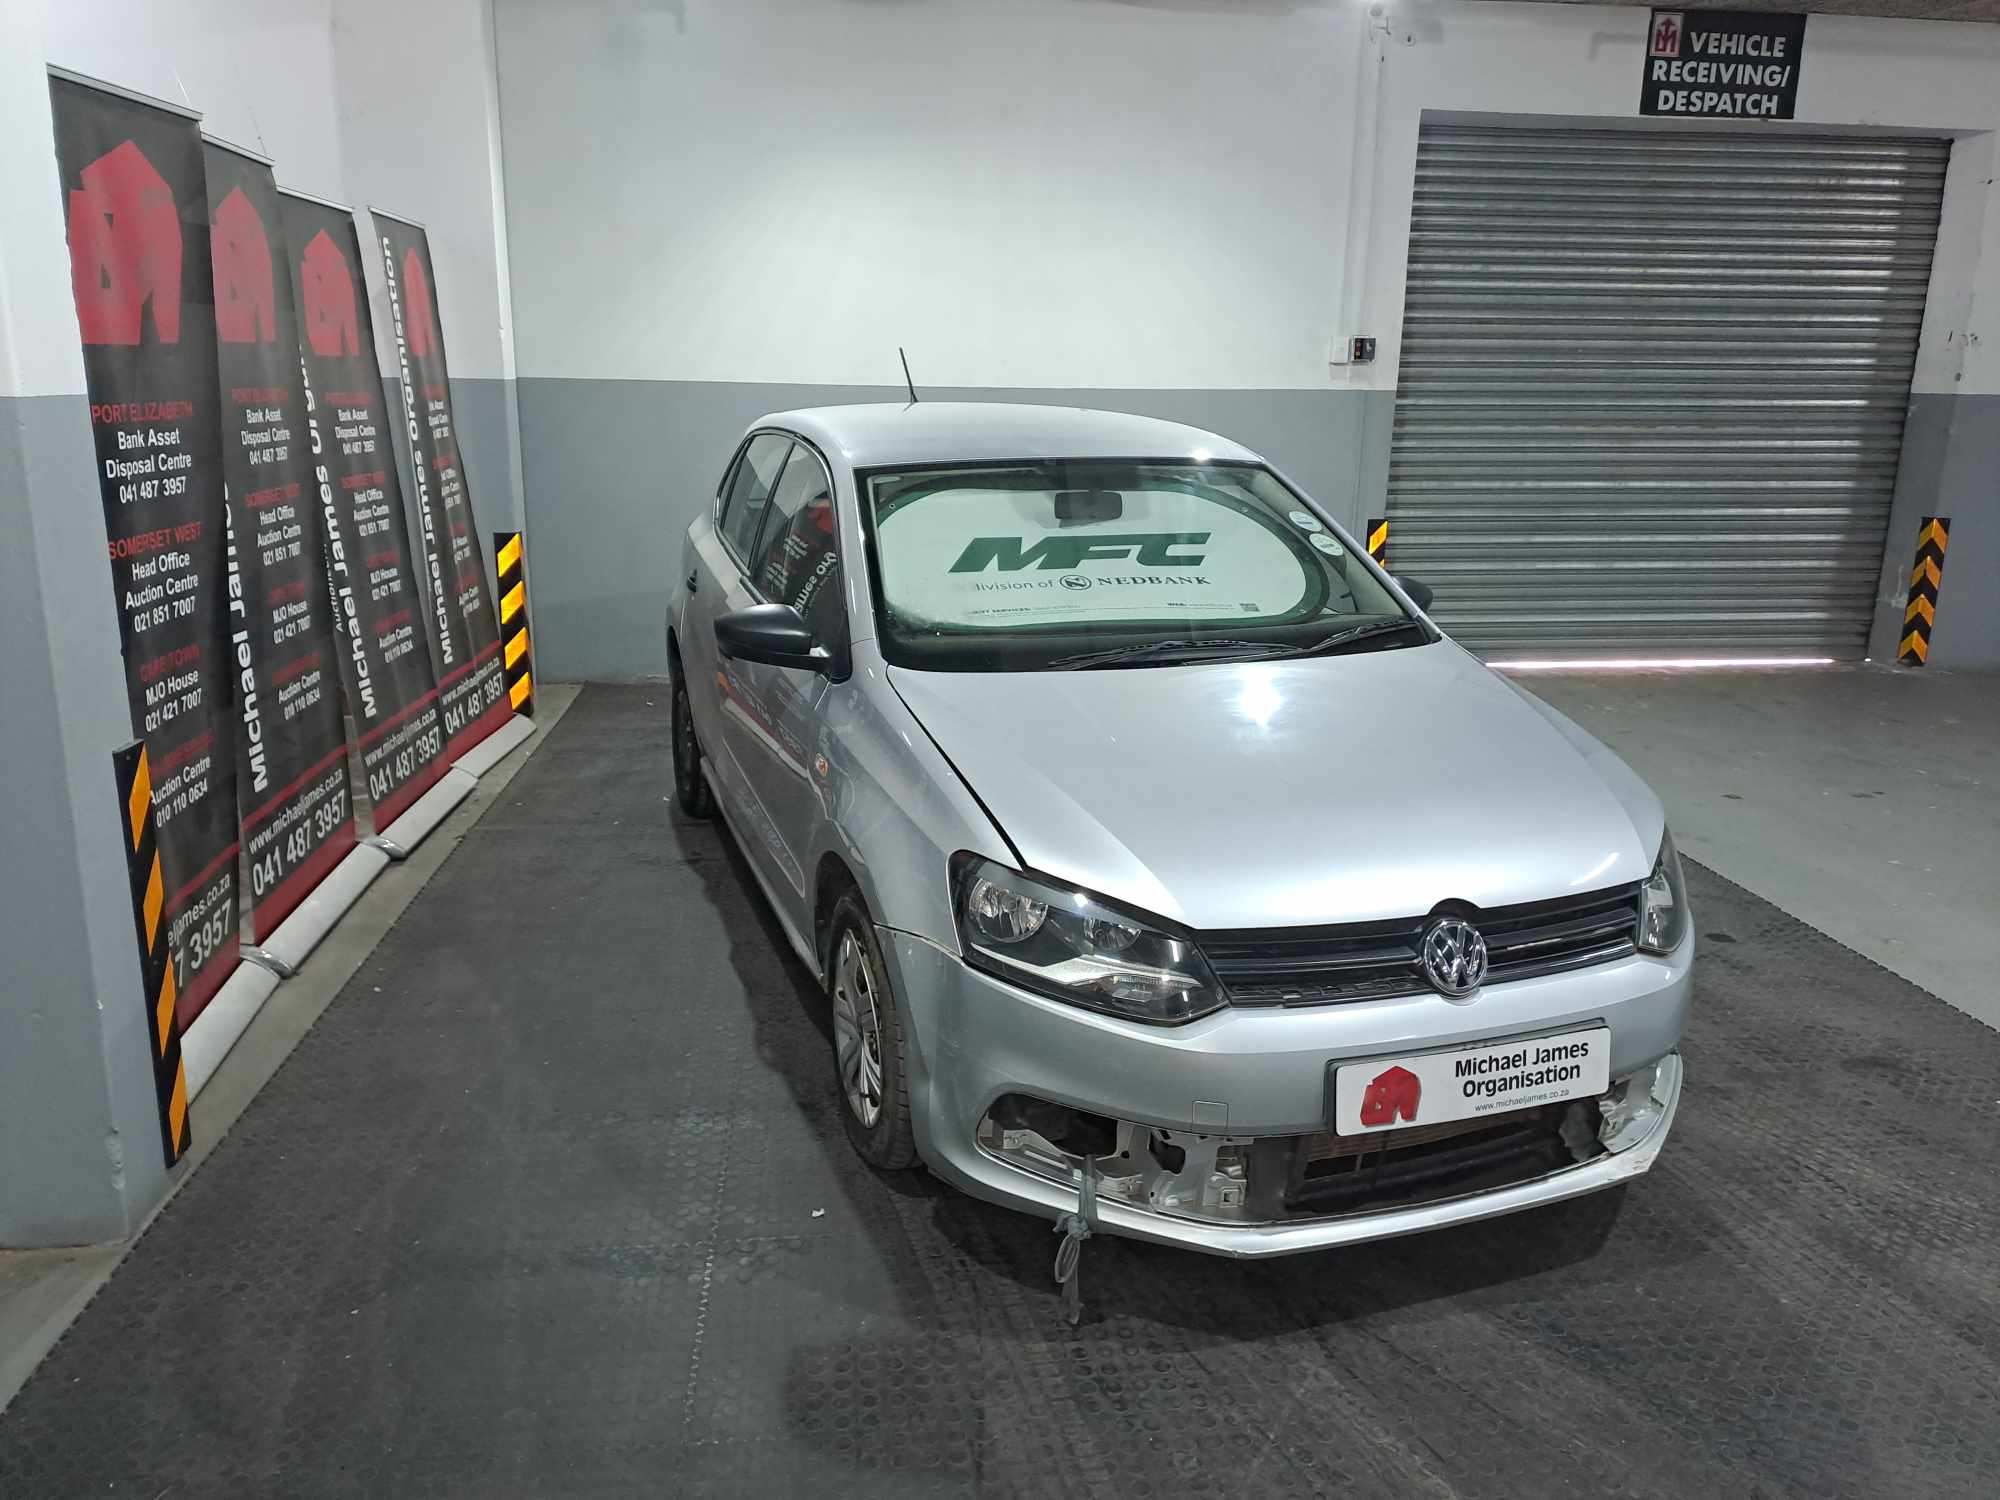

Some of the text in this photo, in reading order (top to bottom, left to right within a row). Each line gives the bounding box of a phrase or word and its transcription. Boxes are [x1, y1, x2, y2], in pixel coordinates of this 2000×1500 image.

[1690, 31, 1787, 58] VEHICLE
[1652, 60, 1791, 88] RECEIVING/
[1657, 90, 1779, 115] DESPATCH
[118, 427, 180, 450] Bank Asset
[106, 453, 192, 480] Disposal Centre
[120, 476, 187, 504] 041 487 3957
[414, 450, 435, 544] James
[109, 532, 173, 560] SOMERSET
[948, 532, 1211, 573] MFC
[131, 551, 190, 581] Head Office
[1038, 580, 1053, 589] of
[1097, 576, 1212, 587] NEDBANK
[125, 572, 199, 610] Auction Centre
[316, 465, 377, 719] Michael James
[428, 553, 454, 665] Michael
[134, 595, 196, 632] 021 851 7007
[146, 670, 199, 706] MJO House
[444, 703, 465, 734] 041
[484, 671, 504, 704] 3957
[145, 688, 202, 732] 021 421 7007
[232, 630, 268, 793] Michael
[183, 756, 210, 783] Centre
[370, 726, 440, 801] 041 487 3957
[156, 804, 170, 828] 010
[253, 788, 345, 896] 041 487 3957
[190, 898, 231, 970] 3957
[1455, 1042, 1589, 1078] Michael James
[1462, 1063, 1581, 1099] Organisation
[1474, 1088, 1570, 1113] www.michaeljames.co.za
